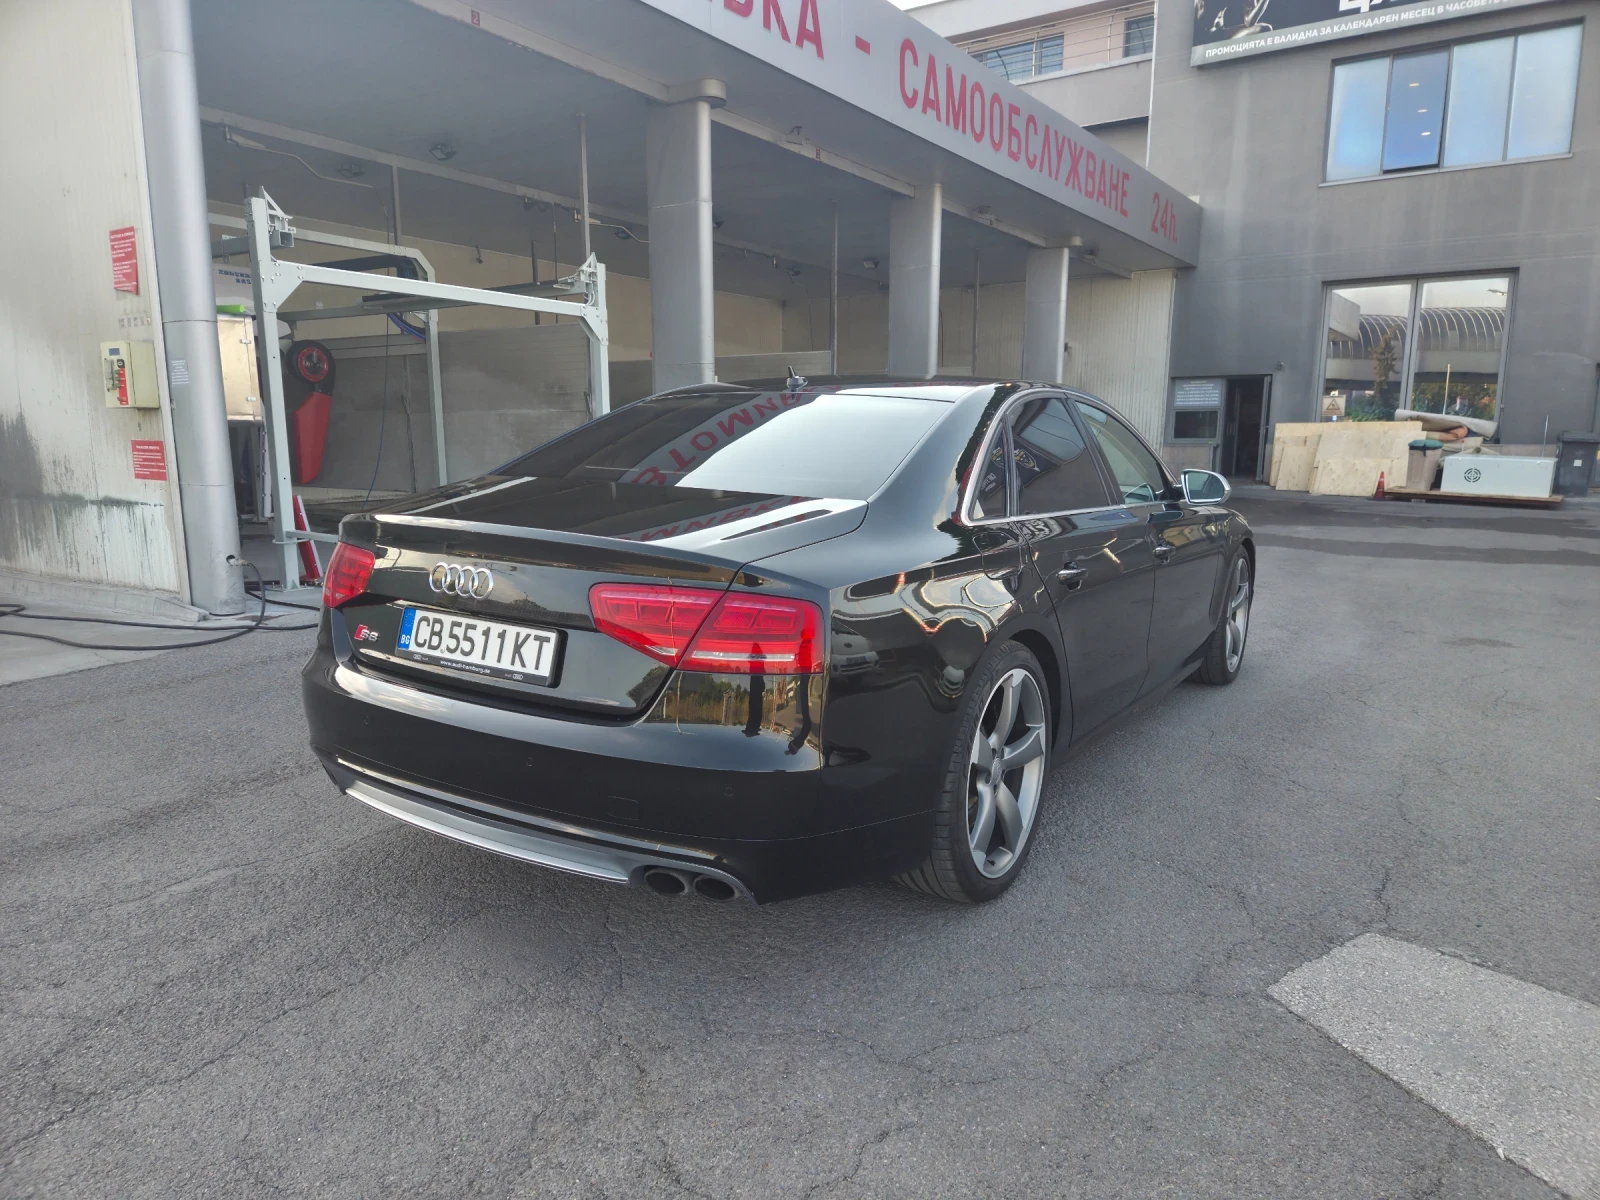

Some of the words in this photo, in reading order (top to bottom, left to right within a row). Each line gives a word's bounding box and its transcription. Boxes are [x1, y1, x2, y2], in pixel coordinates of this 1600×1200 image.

[1205, 39, 1265, 58] ПРОМОЦИЯТА
[1266, 37, 1273, 45] Е
[1274, 29, 1318, 44] ВАЛИДНА
[1320, 25, 1332, 36] ЗА
[1333, 13, 1399, 33] КАЛЕНДАРЕН
[1400, 7, 1435, 20] МЕСЕЦ
[1436, 5, 1444, 14] В
[899, 38, 1130, 218] САМООБСЛУЖВАНЕ
[1150, 192, 1179, 245] 24h.
[400, 634, 411, 645] BG
